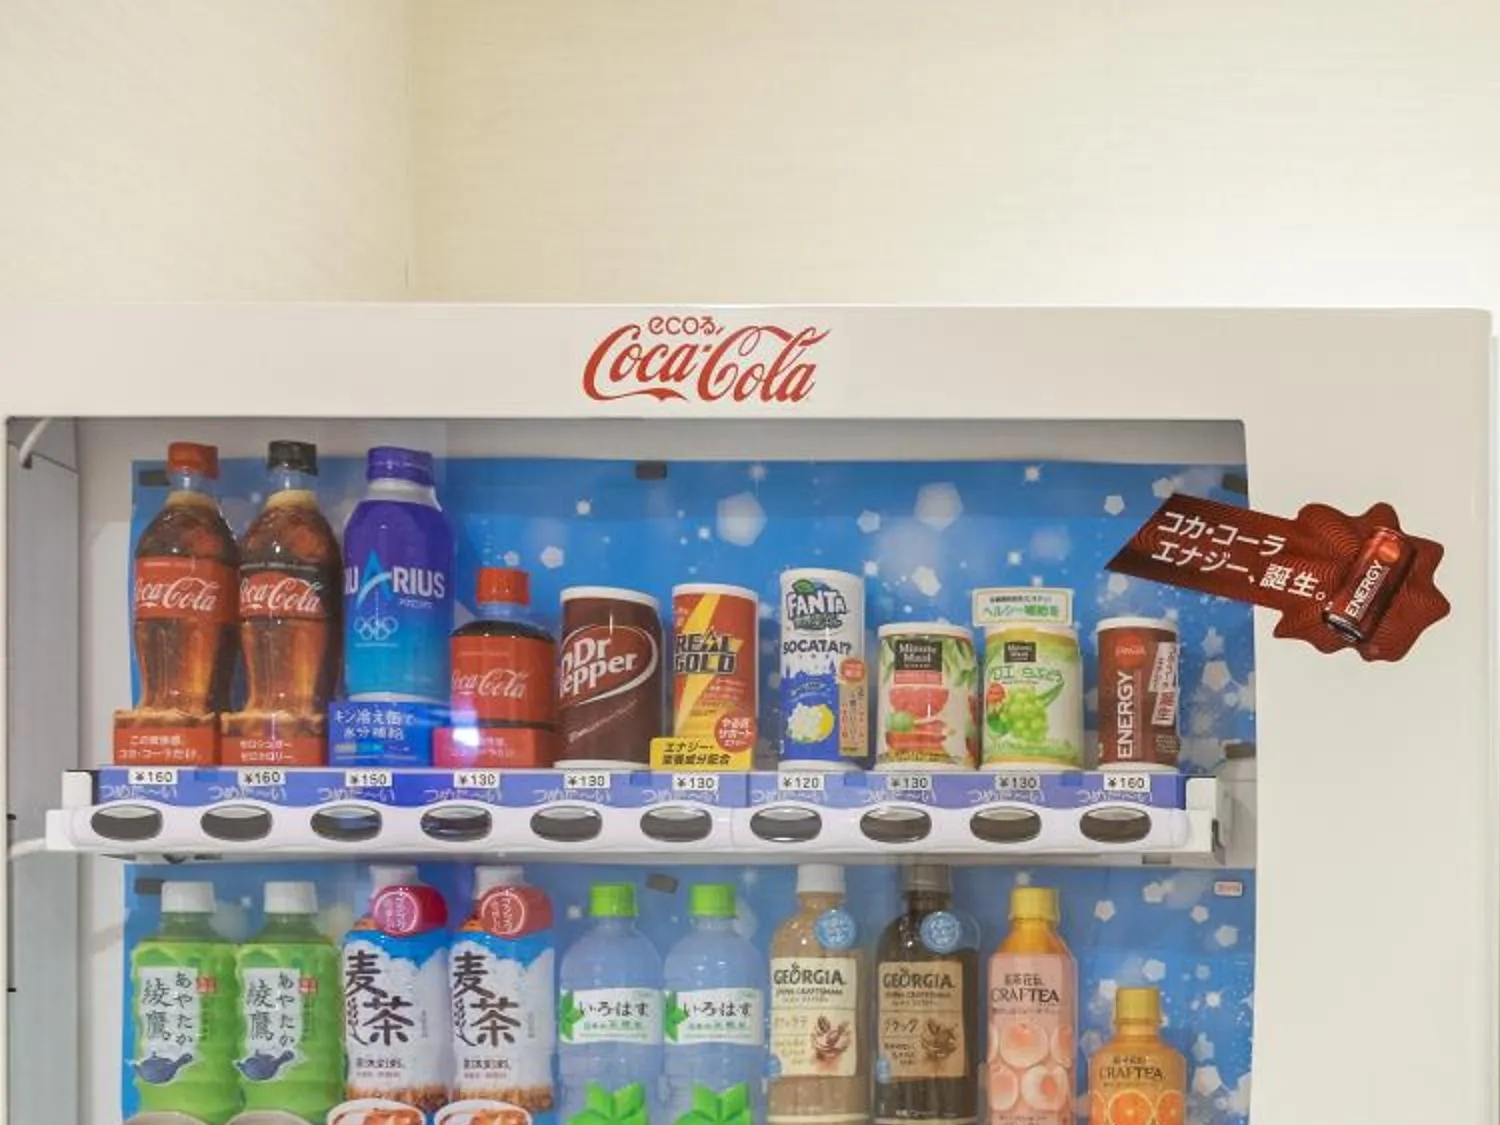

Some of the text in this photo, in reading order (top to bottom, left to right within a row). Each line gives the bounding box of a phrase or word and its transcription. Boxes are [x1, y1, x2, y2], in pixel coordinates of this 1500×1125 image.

[1157, 511, 1287, 557] コカ・コーラ
[787, 590, 848, 620] FANTA
[1345, 560, 1386, 618] ENERGY
[573, 636, 613, 663] Dr
[674, 652, 737, 675] GOLD
[675, 630, 736, 653] REAL
[1116, 671, 1133, 759] ENERGY
[174, 971, 194, 1046] あやたか
[277, 972, 296, 1047] あやたか
[344, 949, 415, 1047] 麦茶
[452, 950, 521, 1048] 麦茶
